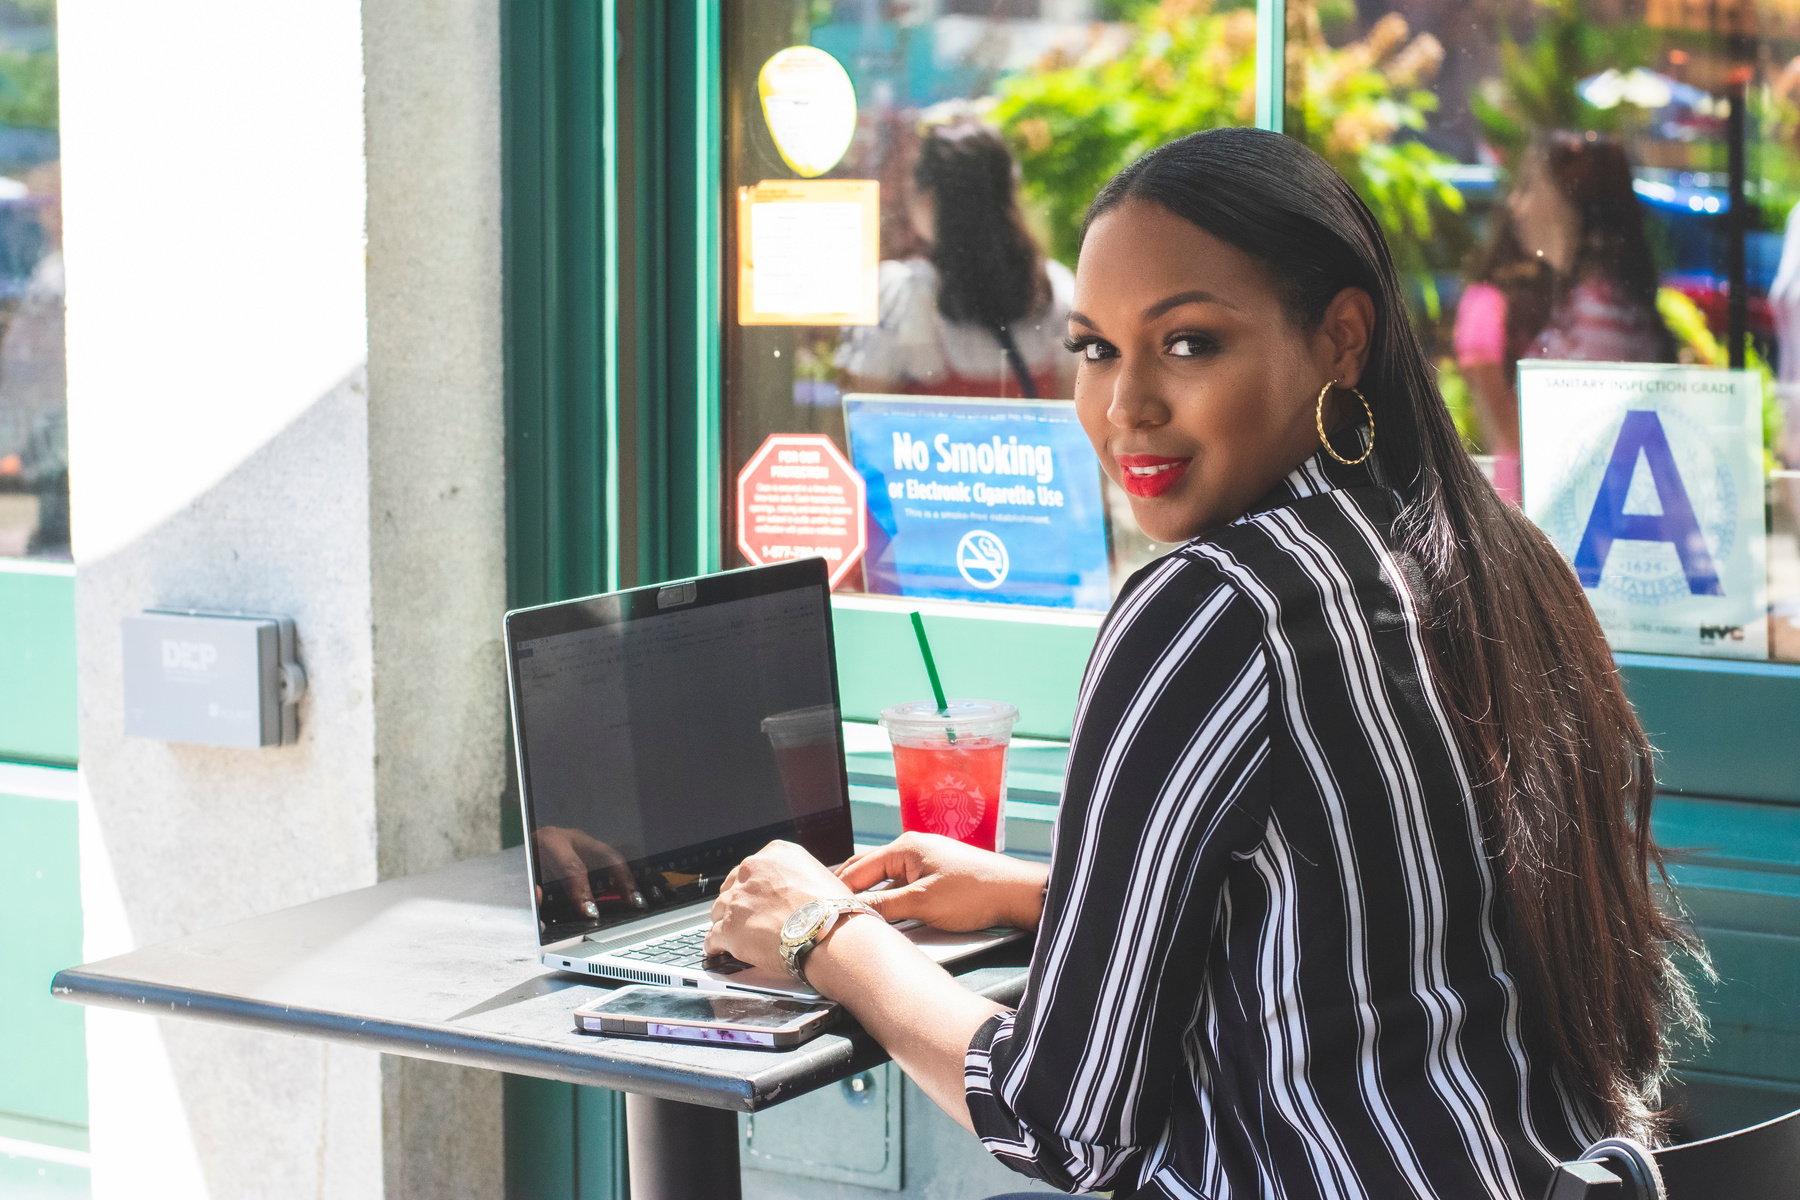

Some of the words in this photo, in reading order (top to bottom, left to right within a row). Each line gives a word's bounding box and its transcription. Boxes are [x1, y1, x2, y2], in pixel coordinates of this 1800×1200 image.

[1546, 378, 1605, 390] SANITARY
[1610, 380, 1687, 394] INSPECTION
[1691, 382, 1737, 396] GRADE
[892, 431, 930, 471] No
[934, 433, 1054, 484] Smoking
[888, 482, 904, 499] or
[905, 478, 971, 503] Electronic
[973, 482, 1036, 507] Cigarette
[1036, 485, 1064, 507] Use
[1574, 409, 1727, 598] A
[904, 507, 923, 518] This
[924, 509, 932, 519] is
[940, 510, 988, 521] smoke-free
[1699, 624, 1745, 642] NYC
[163, 640, 217, 671] DEP
